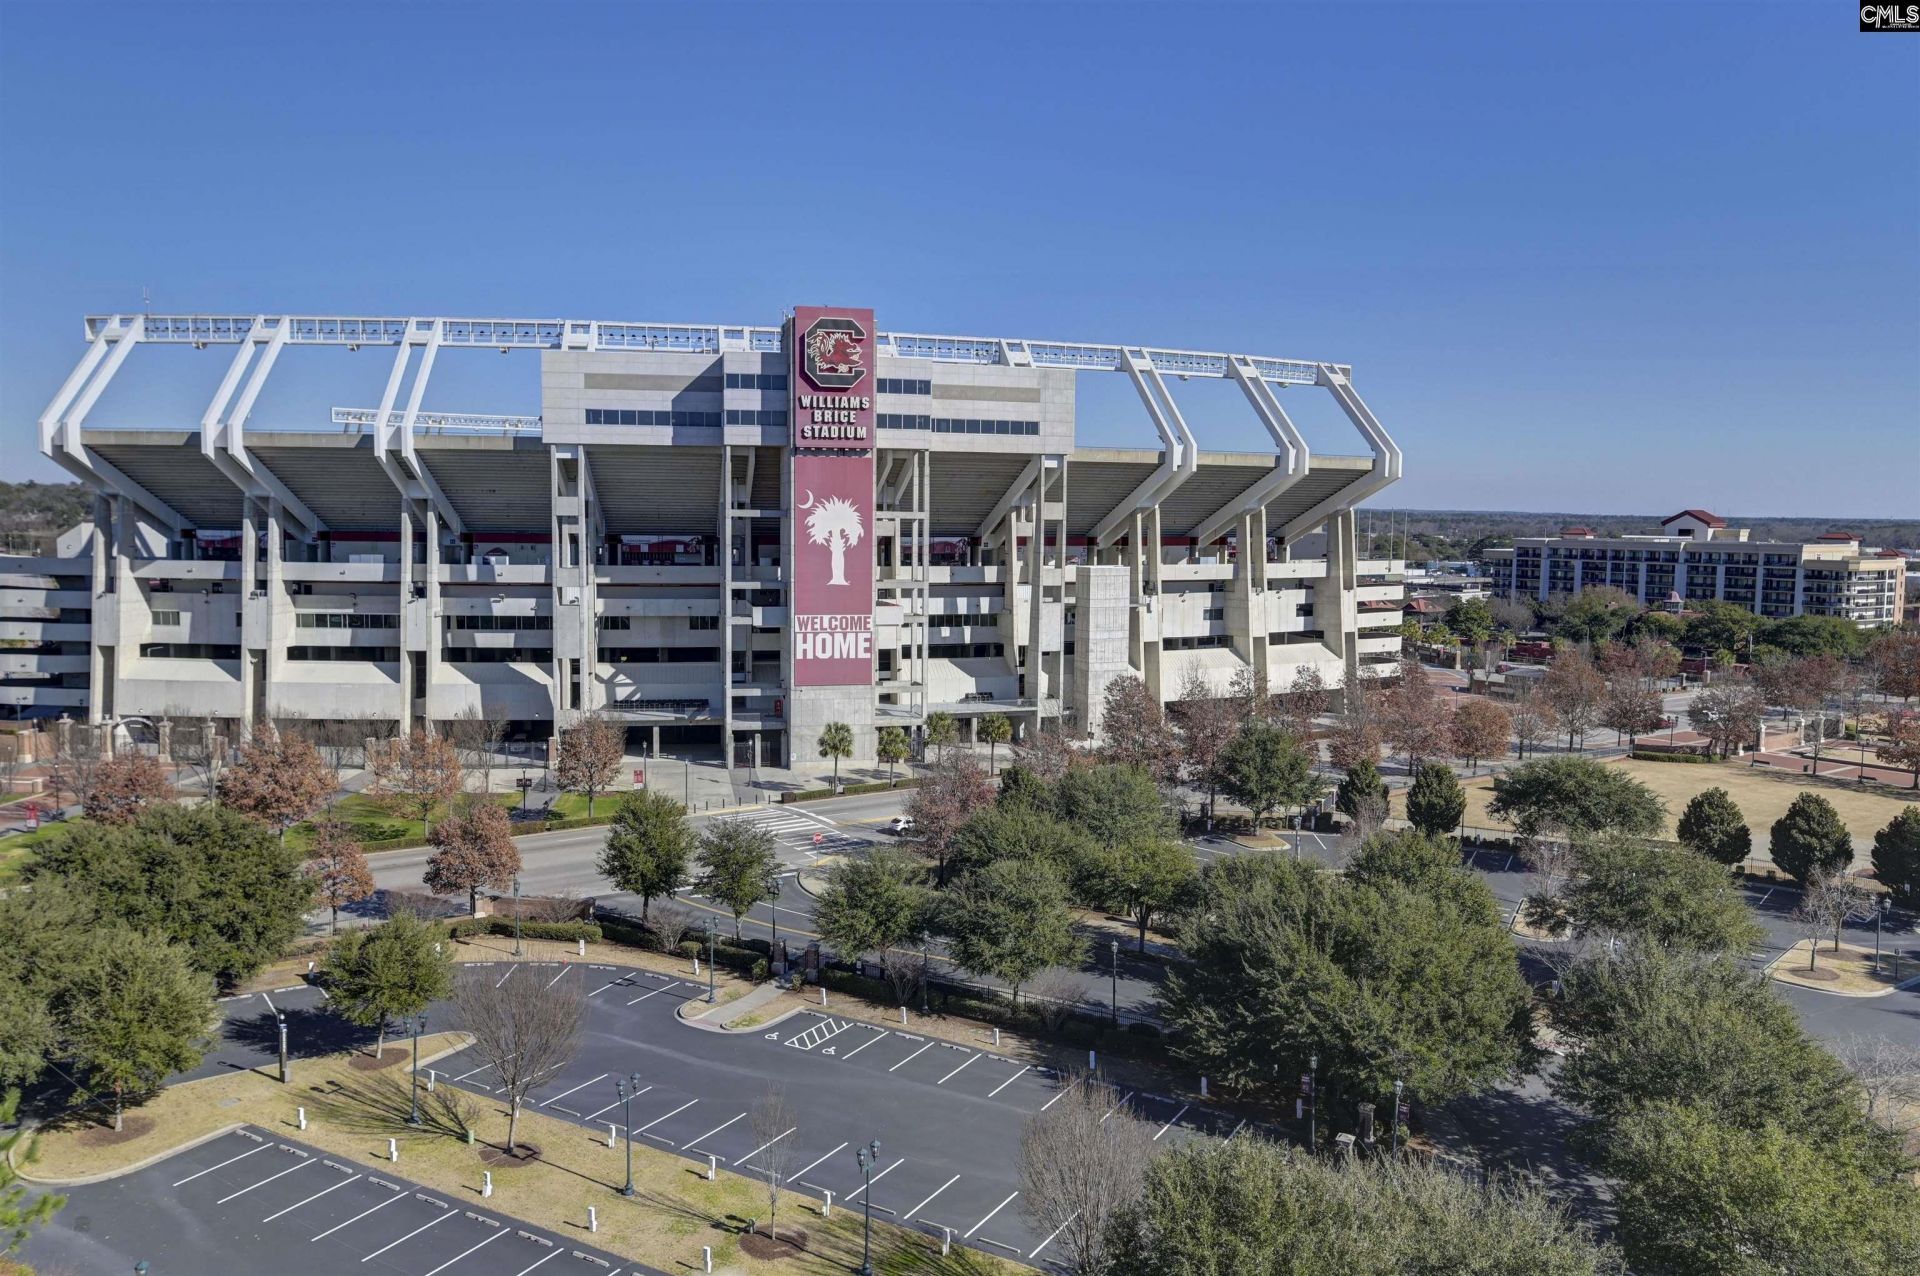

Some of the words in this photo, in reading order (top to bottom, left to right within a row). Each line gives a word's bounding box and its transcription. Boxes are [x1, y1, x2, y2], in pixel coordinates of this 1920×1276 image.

[800, 395, 870, 409] WILLIAMS
[813, 410, 856, 423] BRICE
[803, 425, 867, 439] STADIUM
[797, 617, 871, 631] WELCOME
[796, 633, 871, 659] HOME
